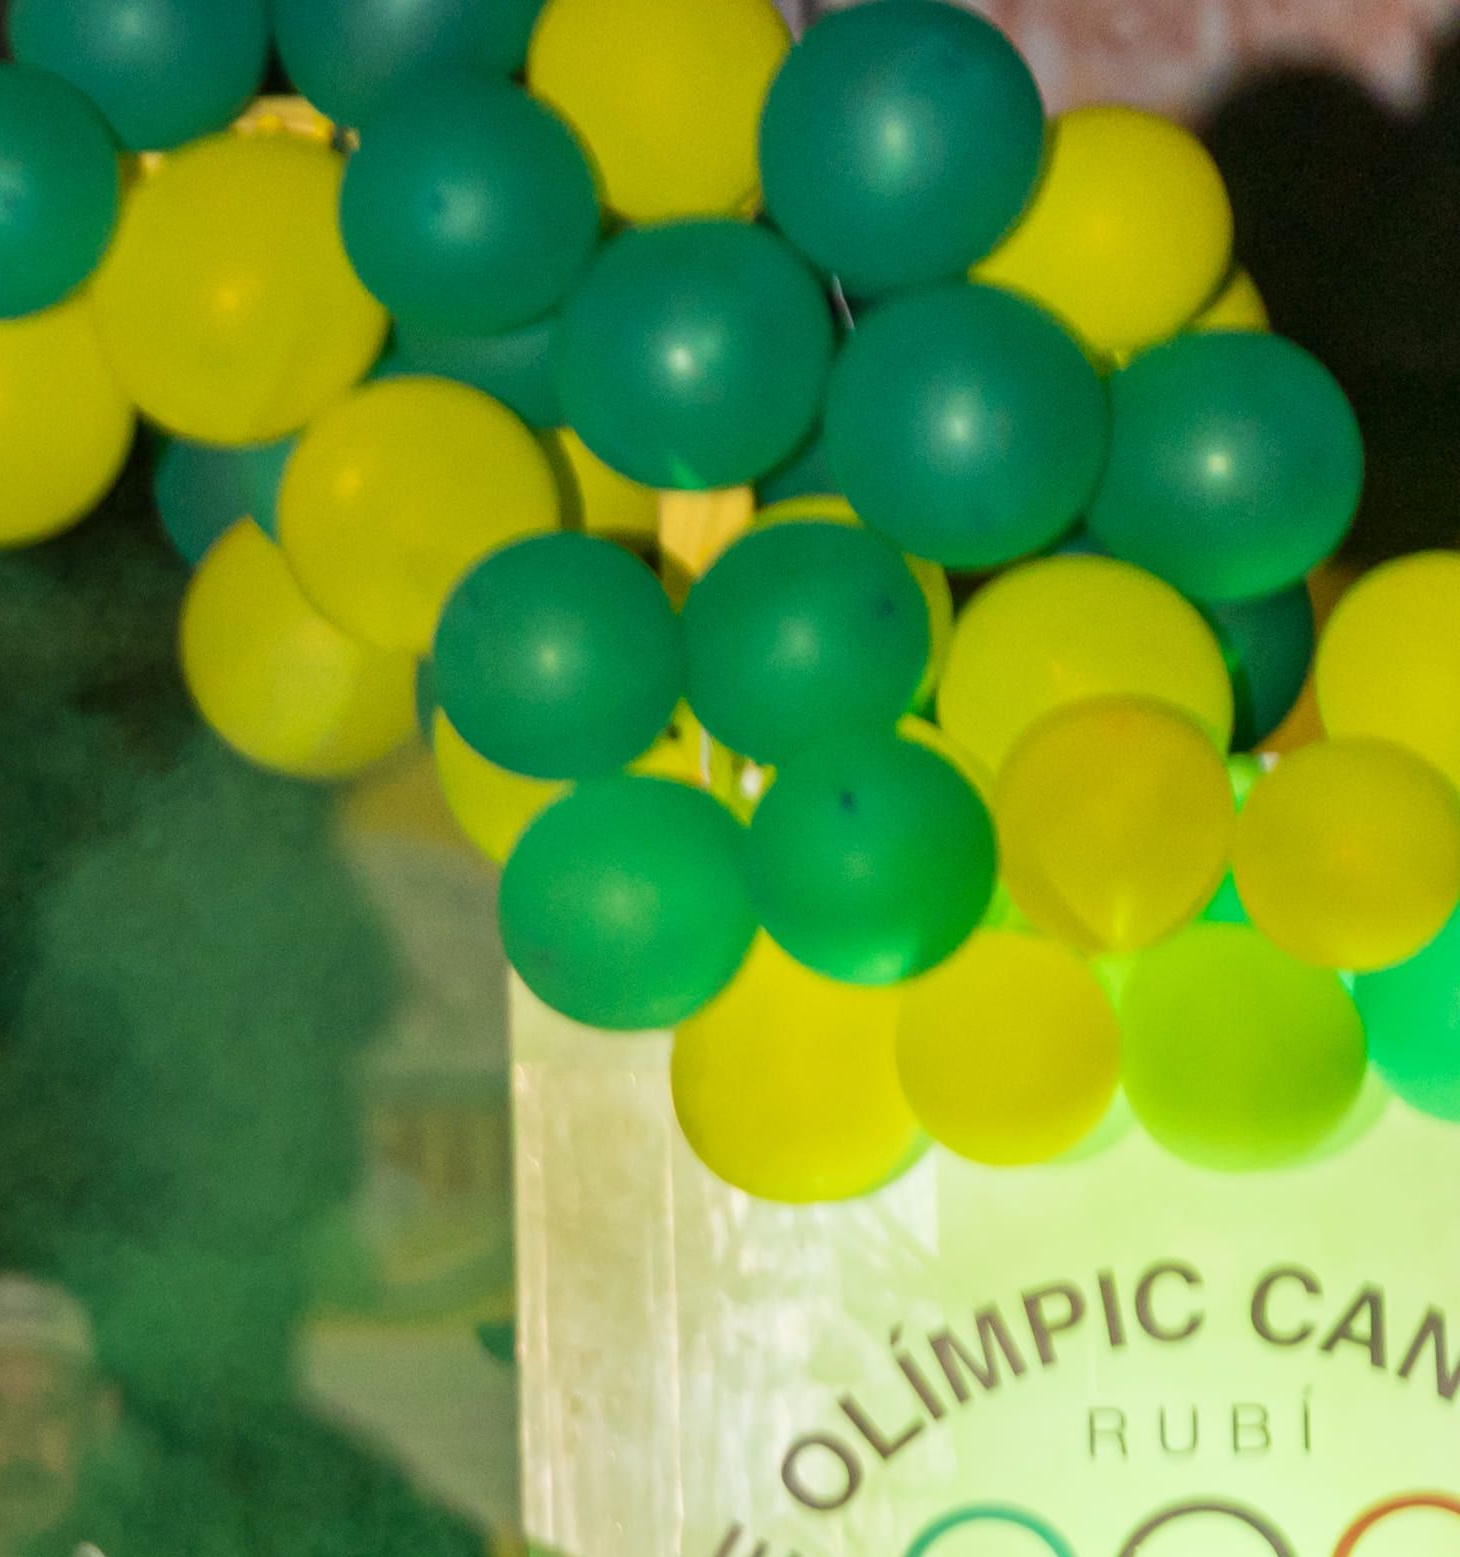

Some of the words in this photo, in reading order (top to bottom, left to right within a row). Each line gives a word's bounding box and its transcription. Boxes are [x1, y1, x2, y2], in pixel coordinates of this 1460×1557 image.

[780, 1256, 1205, 1512] OLÍMPIC
[1250, 1262, 1460, 1402] CAN
[1088, 1383, 1314, 1459] RUBÍ
